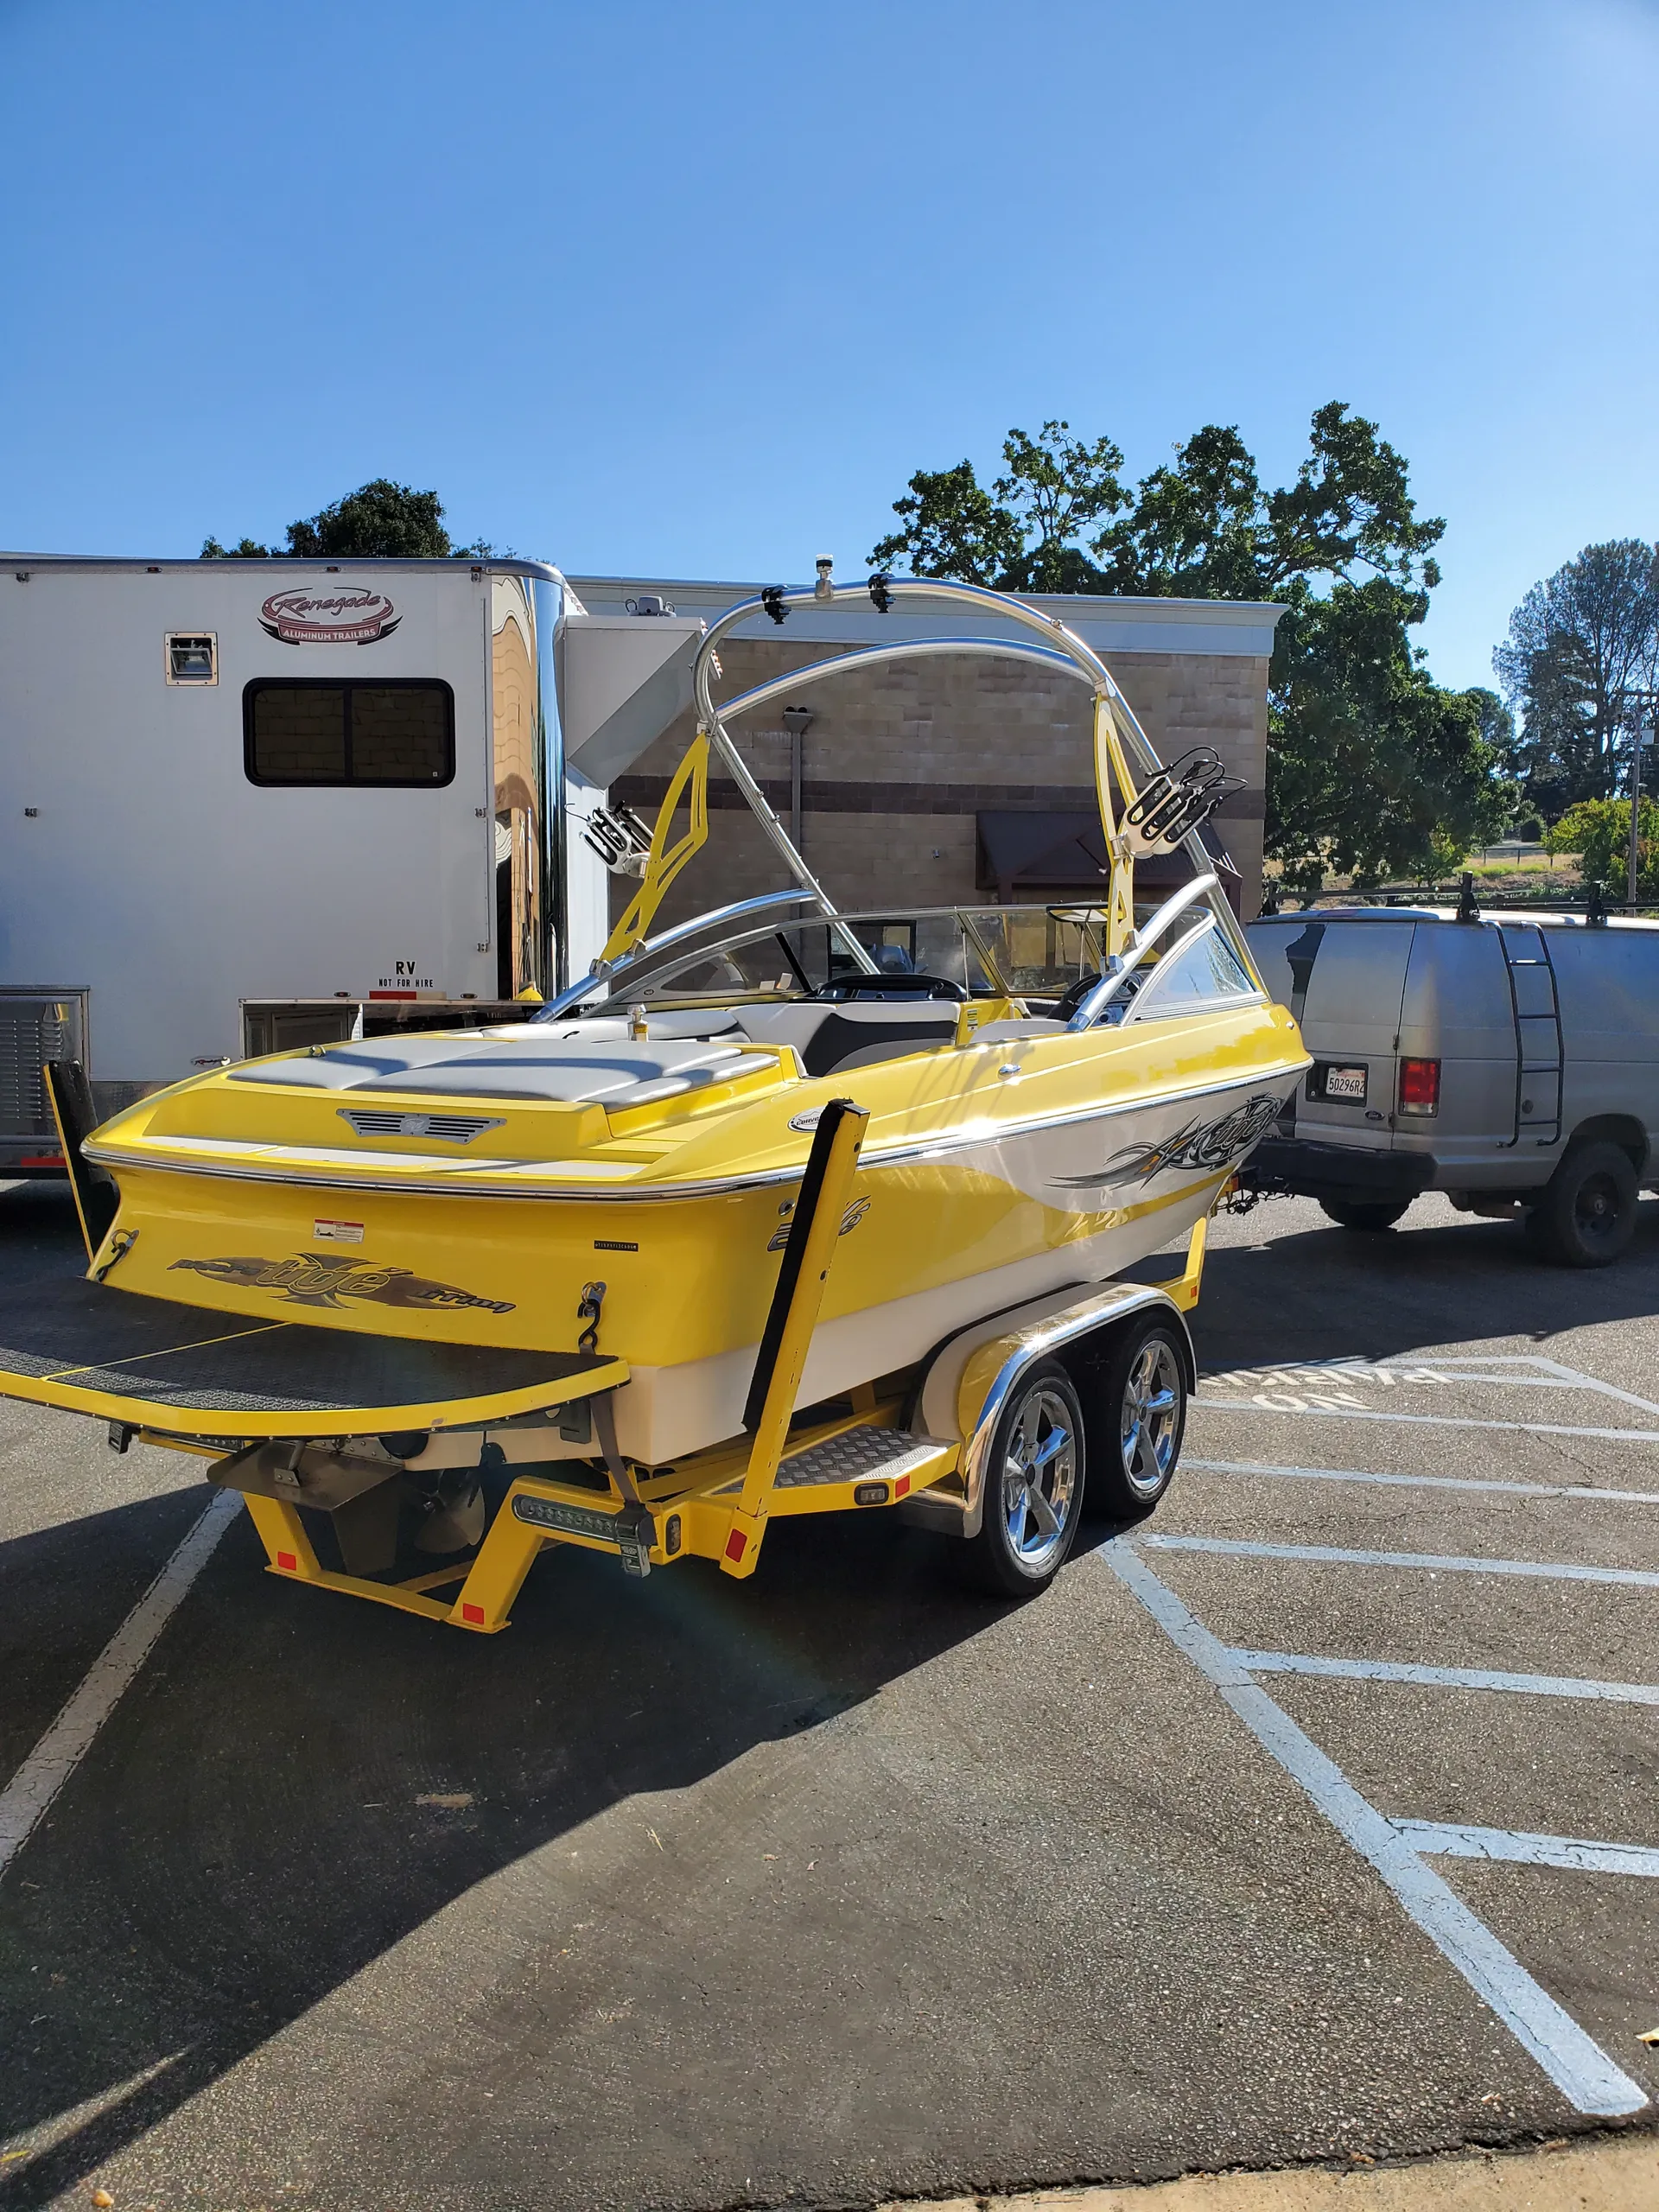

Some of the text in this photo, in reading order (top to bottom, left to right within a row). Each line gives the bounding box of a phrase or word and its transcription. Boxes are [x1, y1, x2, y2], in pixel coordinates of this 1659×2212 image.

[275, 592, 382, 618] Renegade
[283, 629, 377, 640] ALUMINUM TRAILERS
[396, 961, 416, 975] RV
[378, 978, 434, 988] NOT FOR HIRE
[1252, 1392, 1372, 1413] NO
